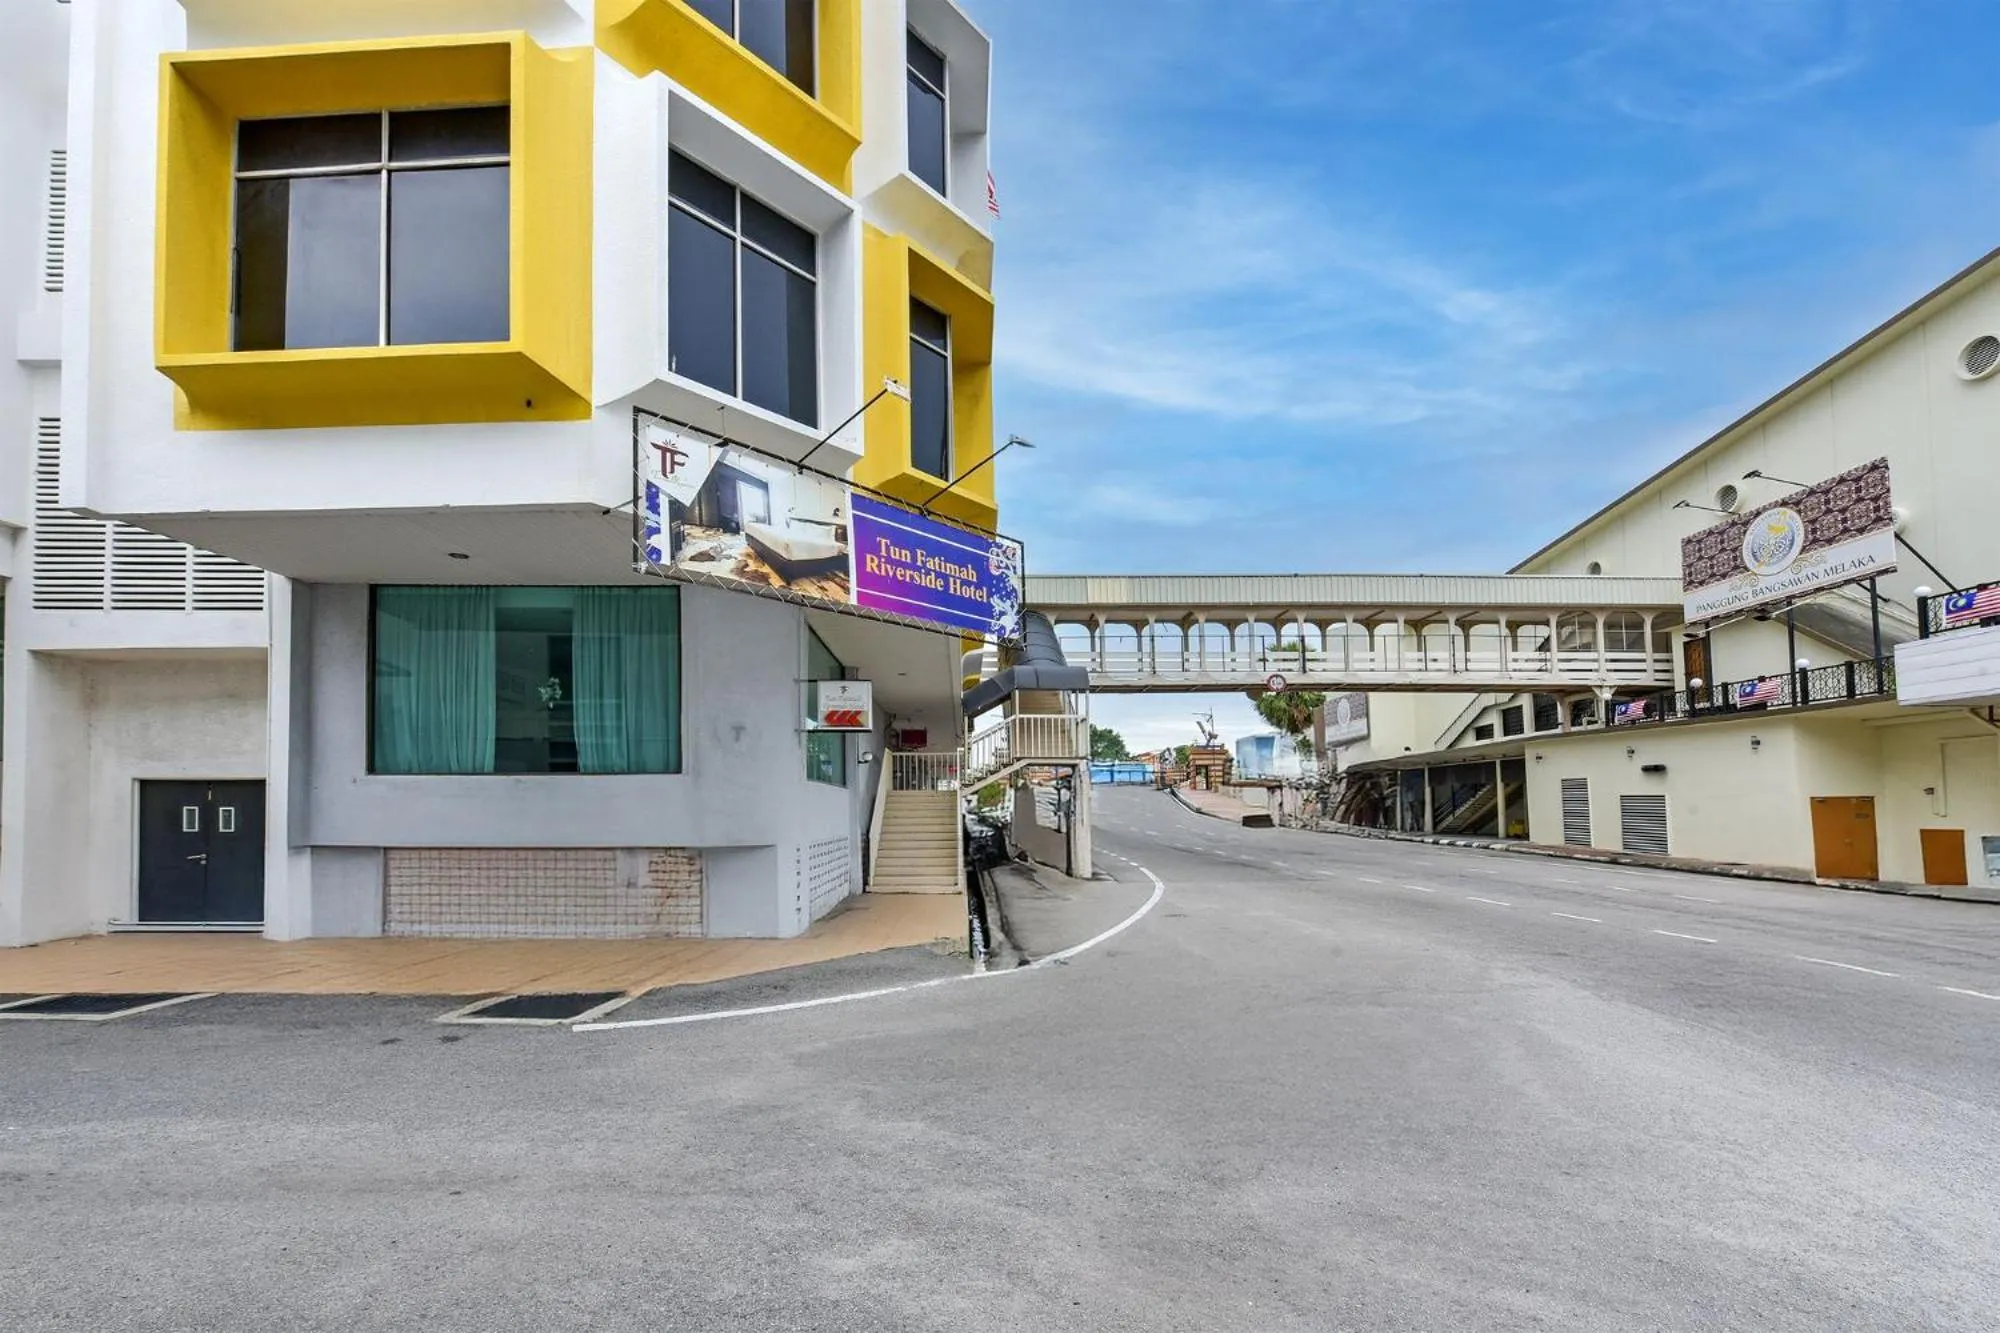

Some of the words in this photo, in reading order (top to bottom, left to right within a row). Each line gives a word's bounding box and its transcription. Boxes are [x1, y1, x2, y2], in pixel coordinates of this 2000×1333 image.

[865, 554, 945, 591] Riverside
[948, 577, 988, 603] Hotel
[877, 536, 911, 563] Tun
[916, 548, 978, 582] Fatimah
[1696, 592, 1750, 613] PANGGUNG
[1751, 570, 1820, 598] BANGSAWAN
[1822, 554, 1876, 578] MELAKA
